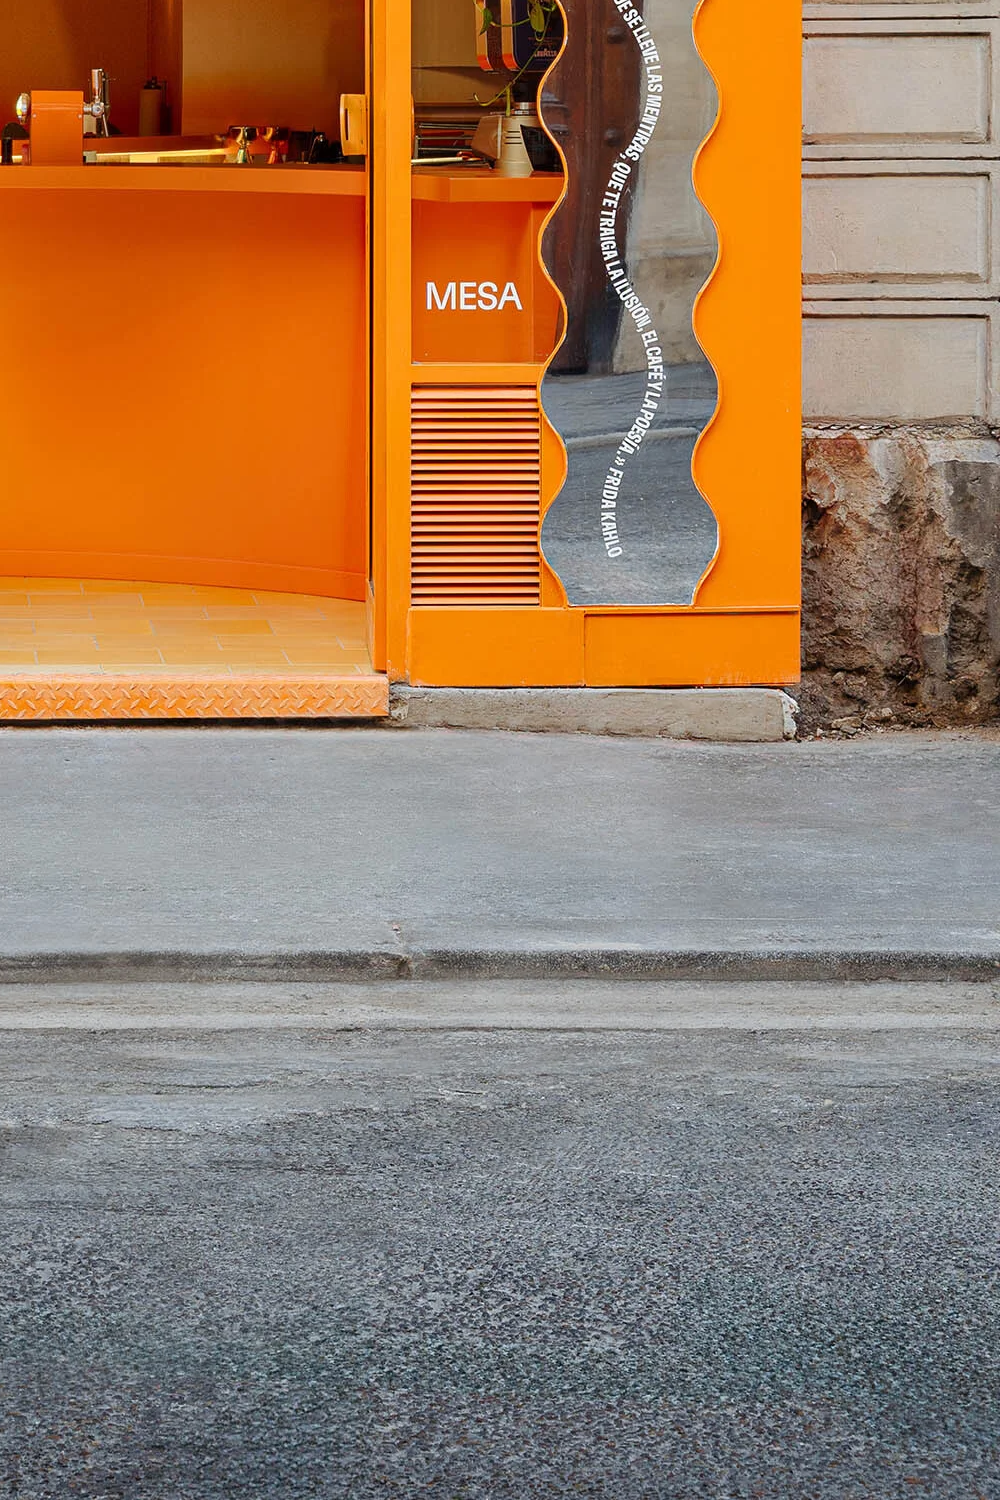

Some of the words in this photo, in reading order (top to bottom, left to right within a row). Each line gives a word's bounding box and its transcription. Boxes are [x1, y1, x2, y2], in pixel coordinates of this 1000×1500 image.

[623, 8, 644, 29] SE
[632, 24, 660, 64] LLEVE
[646, 65, 663, 93] LAS
[619, 94, 662, 162] MENTIRAS,
[607, 161, 631, 191] QUE
[602, 191, 620, 209] TE
[600, 209, 618, 262] TRAIGA
[605, 260, 625, 281] LA
[426, 281, 523, 311] MESA
[613, 278, 651, 333] ILUSIÓN,
[641, 329, 659, 348] EL
[645, 346, 667, 380] CAFÉ
[642, 391, 660, 410] LA
[647, 381, 663, 393] Y
[601, 467, 624, 509] FRIDA
[601, 511, 623, 558] KAHLO
